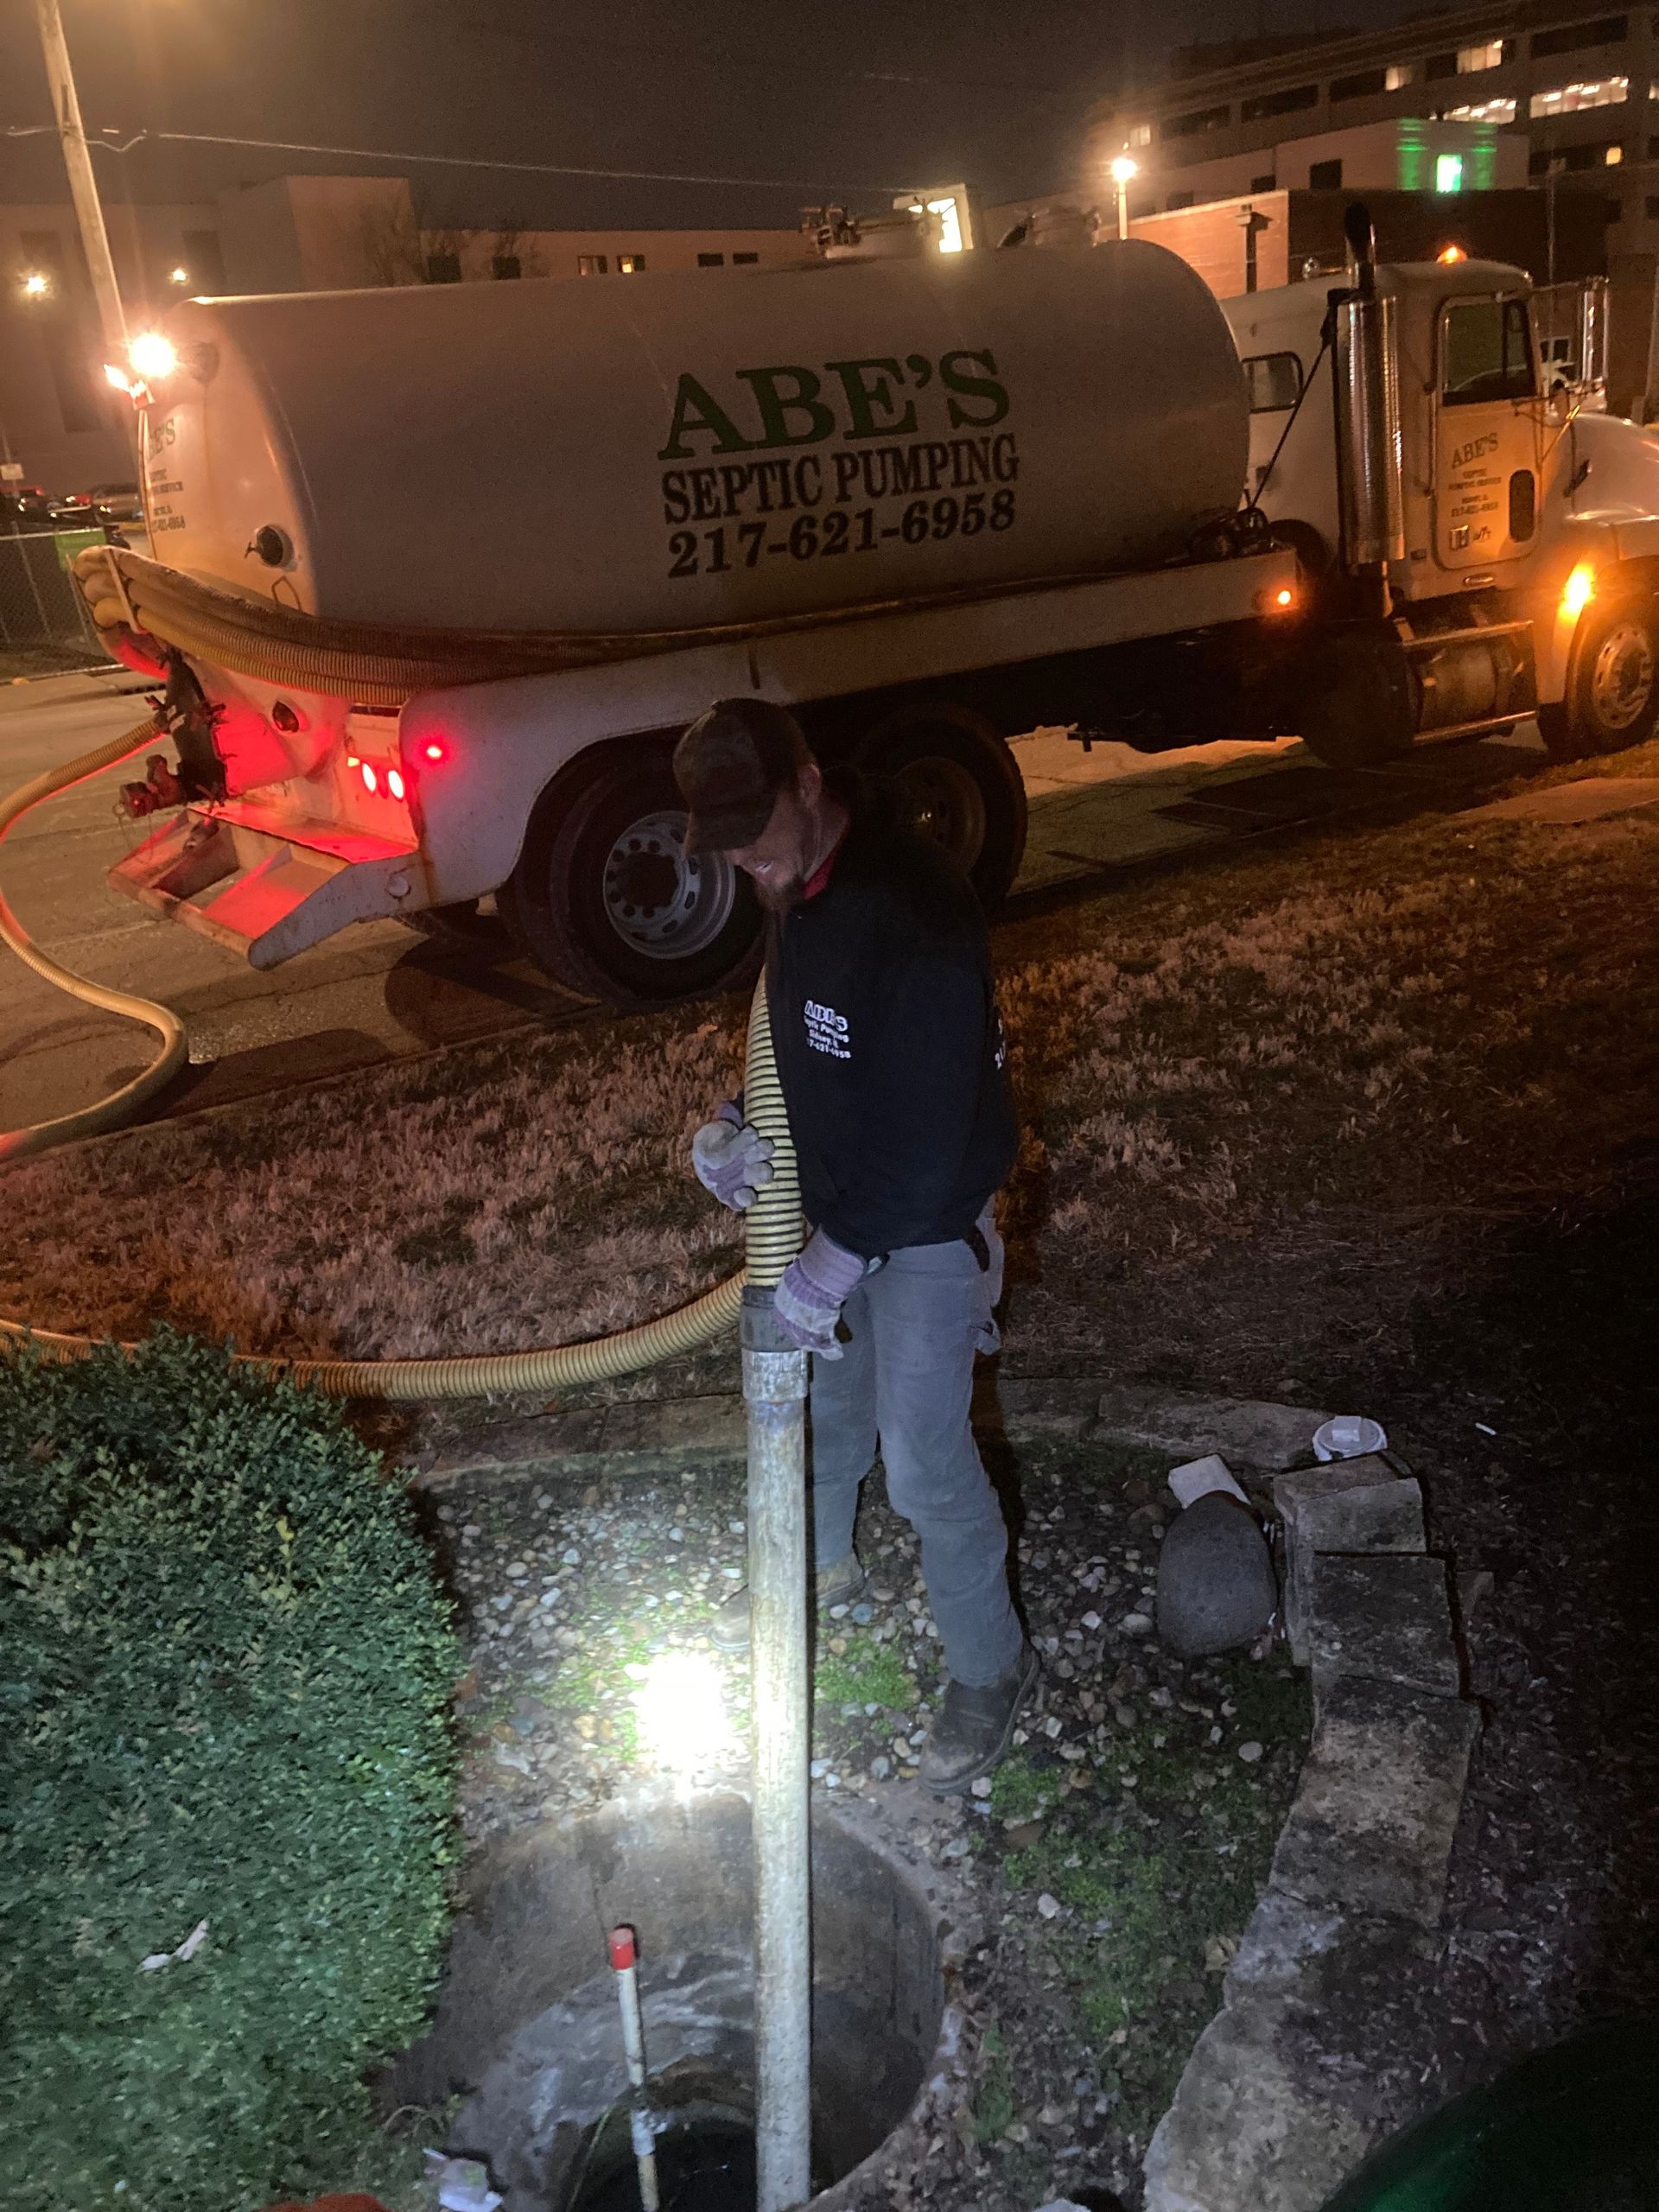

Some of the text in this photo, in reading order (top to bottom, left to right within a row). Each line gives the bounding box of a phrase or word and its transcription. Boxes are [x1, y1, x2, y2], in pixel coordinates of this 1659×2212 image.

[658, 348, 1010, 461] ABE'S
[662, 433, 1020, 524] SEPTIC PUMPING
[668, 488, 1015, 578] 217-621-6958
